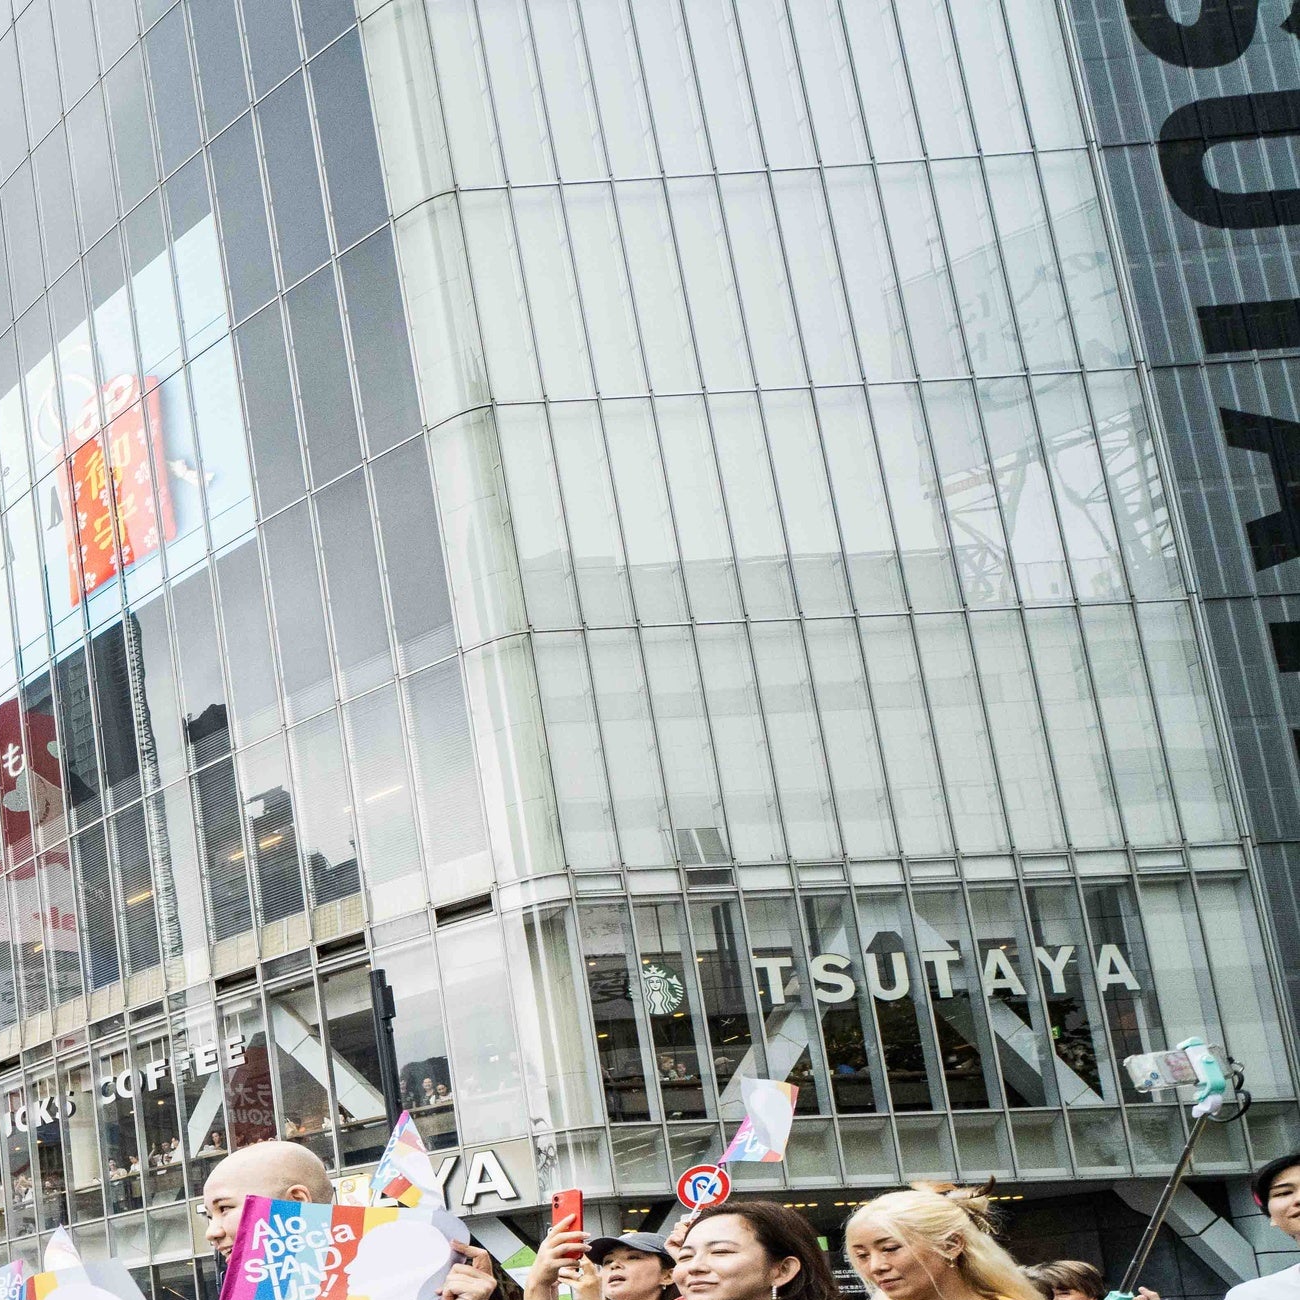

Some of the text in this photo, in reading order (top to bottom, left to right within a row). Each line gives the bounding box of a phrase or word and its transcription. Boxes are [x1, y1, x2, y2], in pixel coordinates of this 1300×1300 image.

[754, 944, 1141, 1003] TSUTAYA
[99, 1035, 247, 1105] COFFEE
[250, 1211, 306, 1251] Alo
[263, 1219, 357, 1266] pecia
[244, 1245, 345, 1289] STAND
